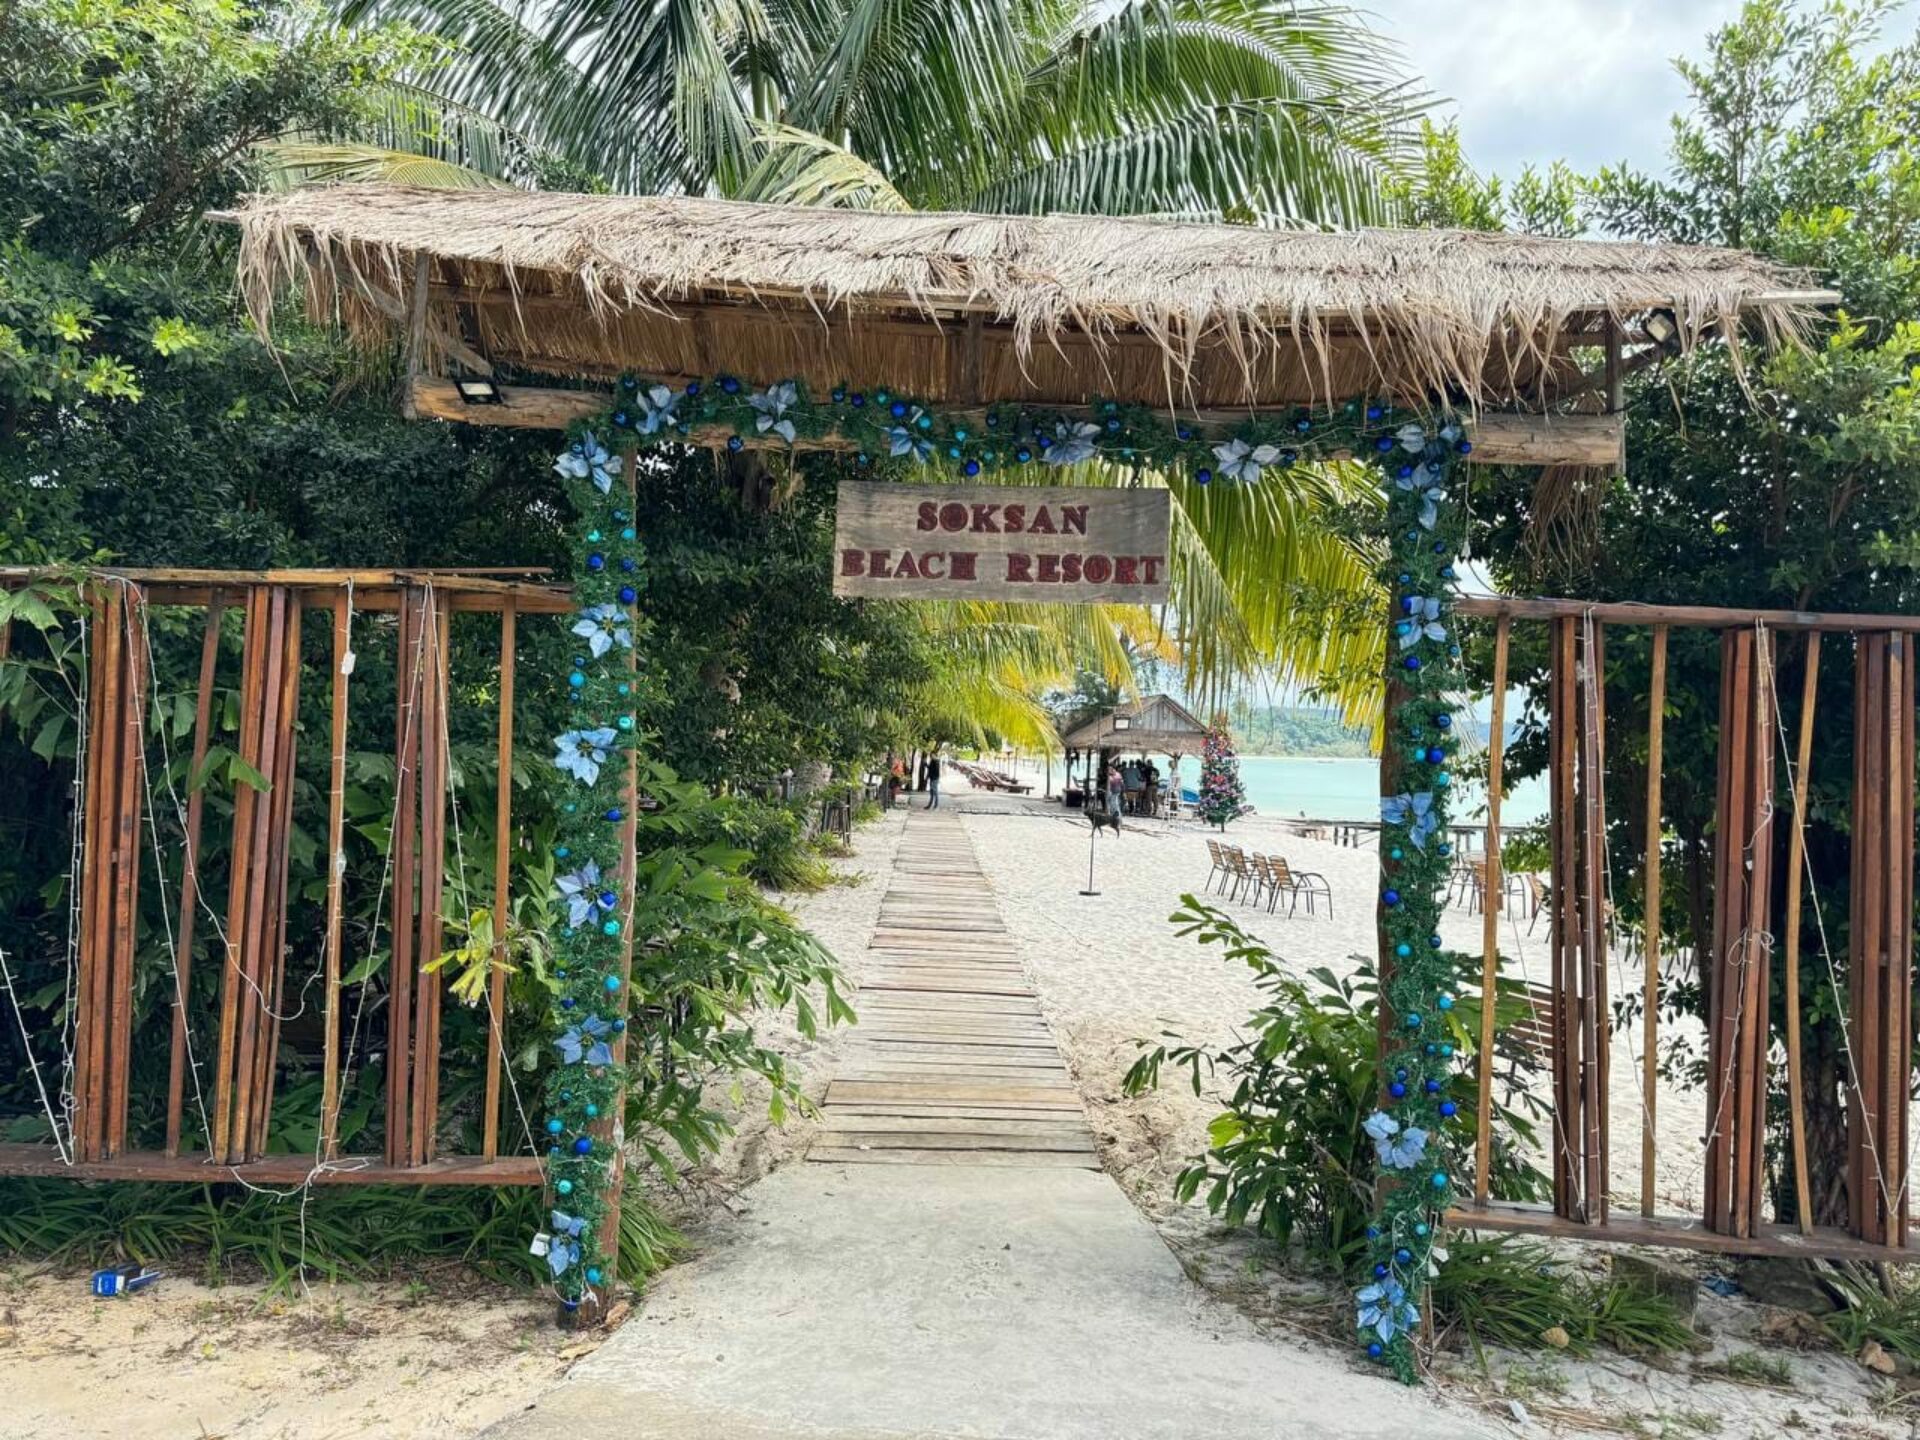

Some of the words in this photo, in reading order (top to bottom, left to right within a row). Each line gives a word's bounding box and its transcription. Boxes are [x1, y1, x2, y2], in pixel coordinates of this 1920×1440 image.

[917, 501, 1090, 535] SOKSAN
[841, 549, 978, 581] BEACH
[1005, 553, 1165, 585] RESORT
